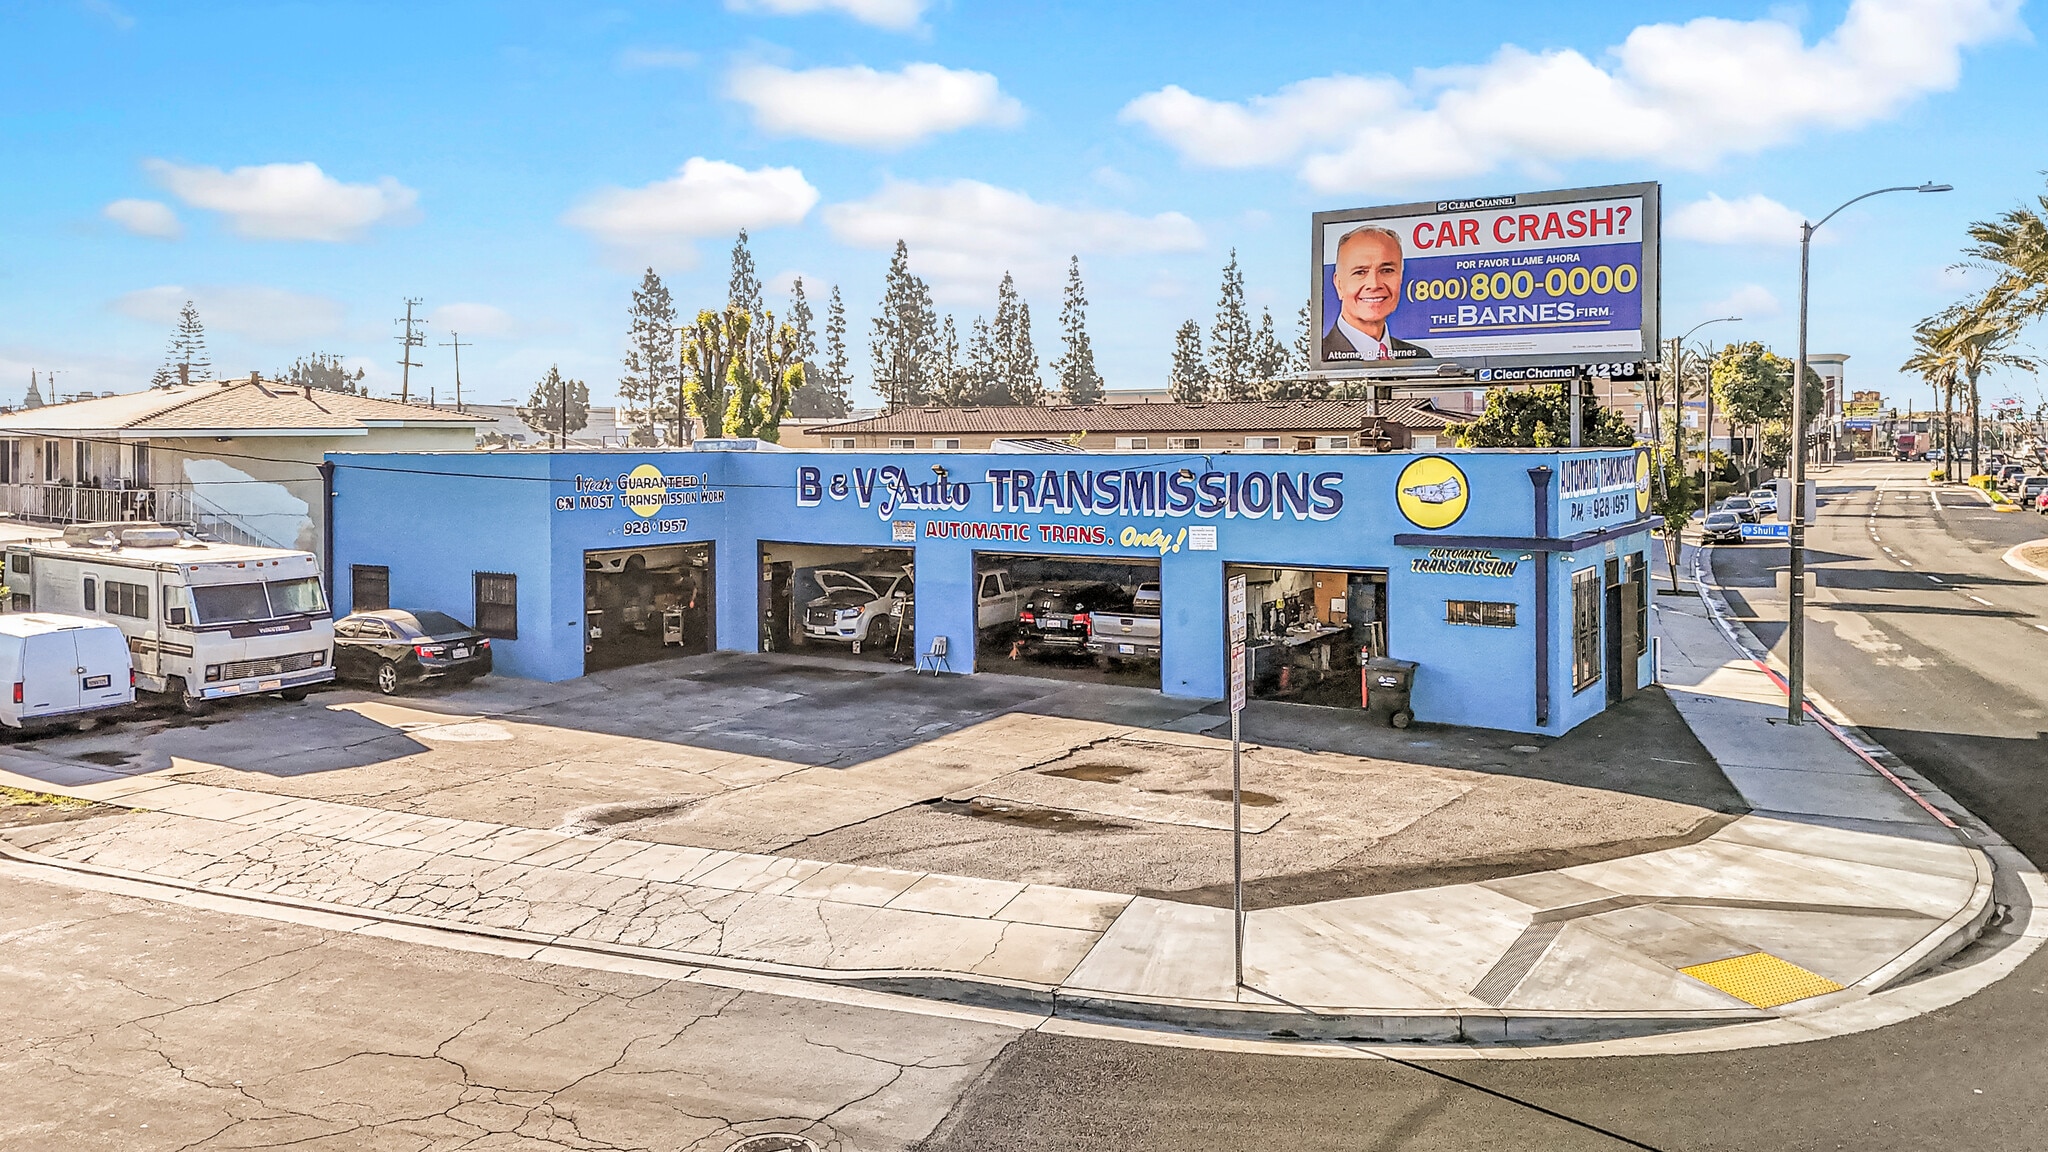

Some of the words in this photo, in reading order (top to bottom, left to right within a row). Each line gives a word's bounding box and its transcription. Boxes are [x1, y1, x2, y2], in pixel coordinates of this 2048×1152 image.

[1412, 219, 1480, 249] CAR
[1493, 206, 1632, 243] CRASH?
[1456, 260, 1476, 270] POR
[1478, 258, 1509, 268] FAVOR
[1512, 256, 1543, 266] LLAME
[1546, 254, 1580, 263] AHORA
[1431, 315, 1456, 324] THE
[1457, 302, 1576, 326] BARNES
[1576, 307, 1609, 317] FIRM
[1327, 351, 1364, 360] Attorney
[1387, 349, 1417, 357] Barnes
[1494, 369, 1525, 379] Clear
[1526, 366, 1575, 378] Channel
[1586, 363, 1634, 377] 4238
[1560, 459, 1599, 498] AUTOMATIC
[1600, 455, 1635, 492] TRANSMISSION
[580, 495, 614, 510] MOST
[621, 492, 697, 507] TRANSMISSION
[700, 490, 725, 504] WORK
[797, 466, 823, 507] B
[829, 473, 849, 500] &
[853, 467, 877, 508] V
[878, 465, 971, 521] Auto
[985, 469, 1344, 521] TRANSMISSIONS
[925, 520, 1031, 543] AUTOMATIC
[1038, 523, 1115, 546] TRANS.
[1120, 526, 1188, 556] Only!
[1753, 526, 1774, 535] Shull
[1428, 548, 1501, 561] AUTOMATIC
[1411, 559, 1518, 578] TRANSMISSION
